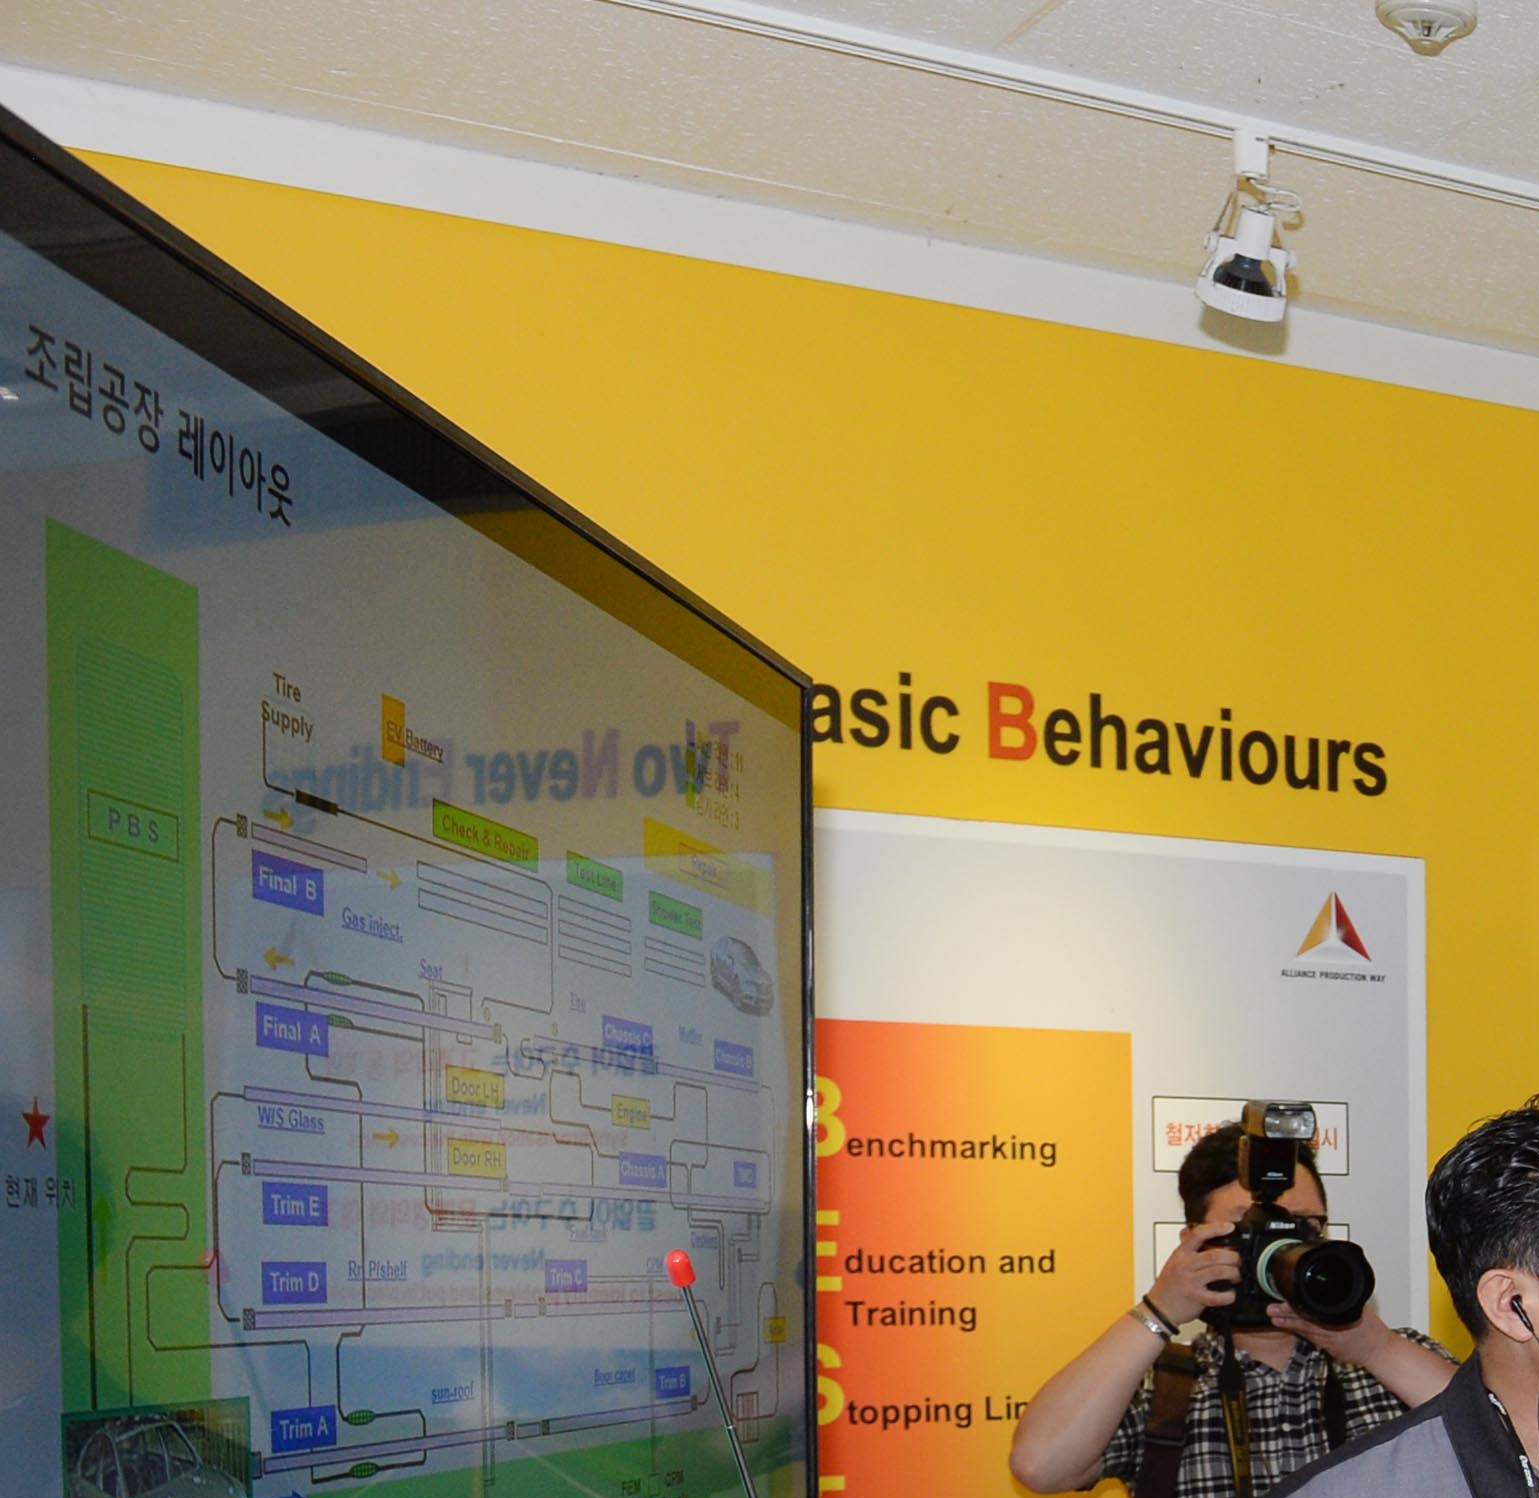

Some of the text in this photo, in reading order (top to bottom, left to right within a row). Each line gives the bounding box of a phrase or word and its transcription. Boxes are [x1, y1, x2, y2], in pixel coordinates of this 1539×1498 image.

[24, 323, 295, 528] 조립공장 레이아웃
[273, 672, 301, 702] Tire
[261, 700, 313, 743] Supply
[405, 728, 444, 760] Battery
[812, 672, 1388, 798] asic Behaviours
[442, 814, 479, 842] Check
[483, 831, 491, 847] &
[258, 866, 317, 901] Final B
[342, 907, 365, 930] Gas
[1281, 968, 1386, 984] ALLIANCE PRODUCTION WAY
[263, 1015, 322, 1044] Final A
[451, 1076, 500, 1099] Door LH
[289, 1109, 324, 1131] Glass
[452, 1147, 501, 1167] Door RH
[4, 1175, 76, 1210] 현재 위치
[271, 1194, 320, 1217] Trim E
[999, 1250, 1056, 1274] and
[270, 1272, 319, 1292] Trim D
[550, 1267, 572, 1285] Trim
[845, 1300, 977, 1332] Training
[431, 1382, 474, 1402] sun-roof
[659, 1375, 676, 1390] Trim
[279, 1417, 328, 1438] Trim A
